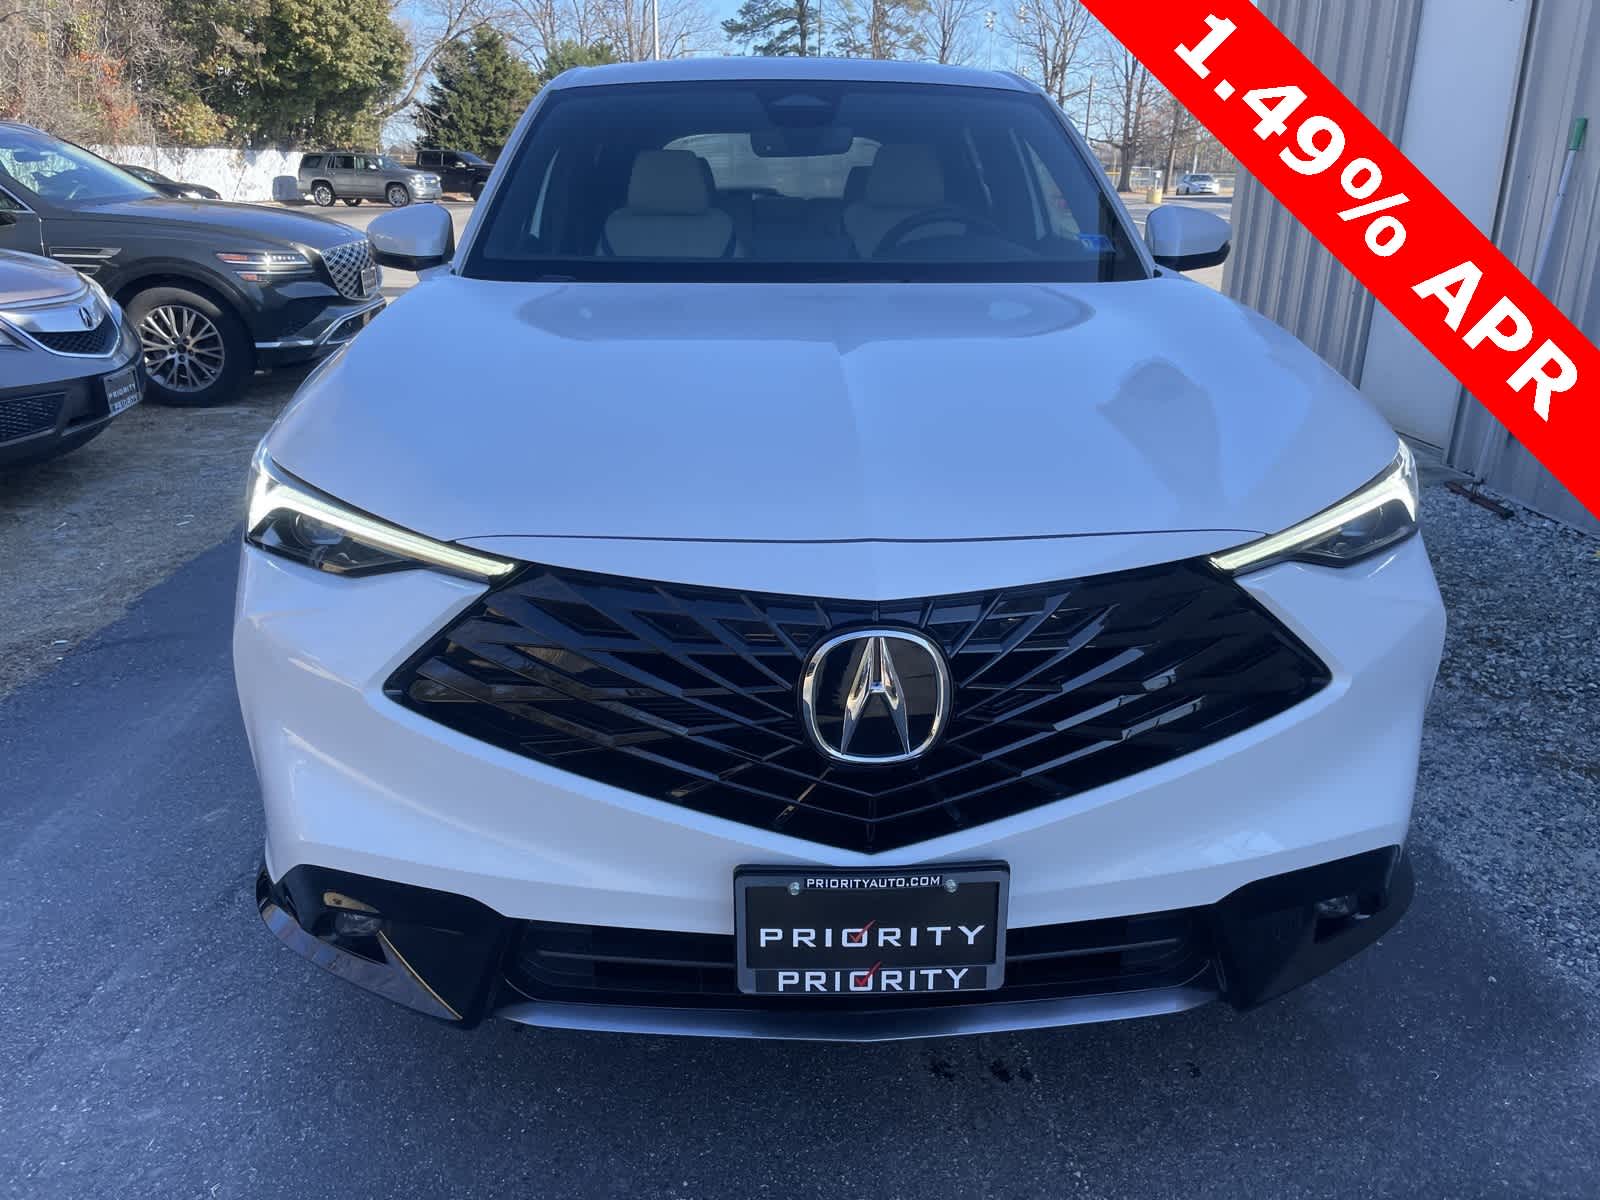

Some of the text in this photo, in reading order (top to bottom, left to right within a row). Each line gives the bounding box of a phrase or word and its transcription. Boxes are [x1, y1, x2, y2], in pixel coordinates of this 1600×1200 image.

[806, 876, 941, 889] PRIORITYAUTO.COM
[759, 924, 985, 948] PRIORITY
[778, 967, 969, 992] PRIORITY
